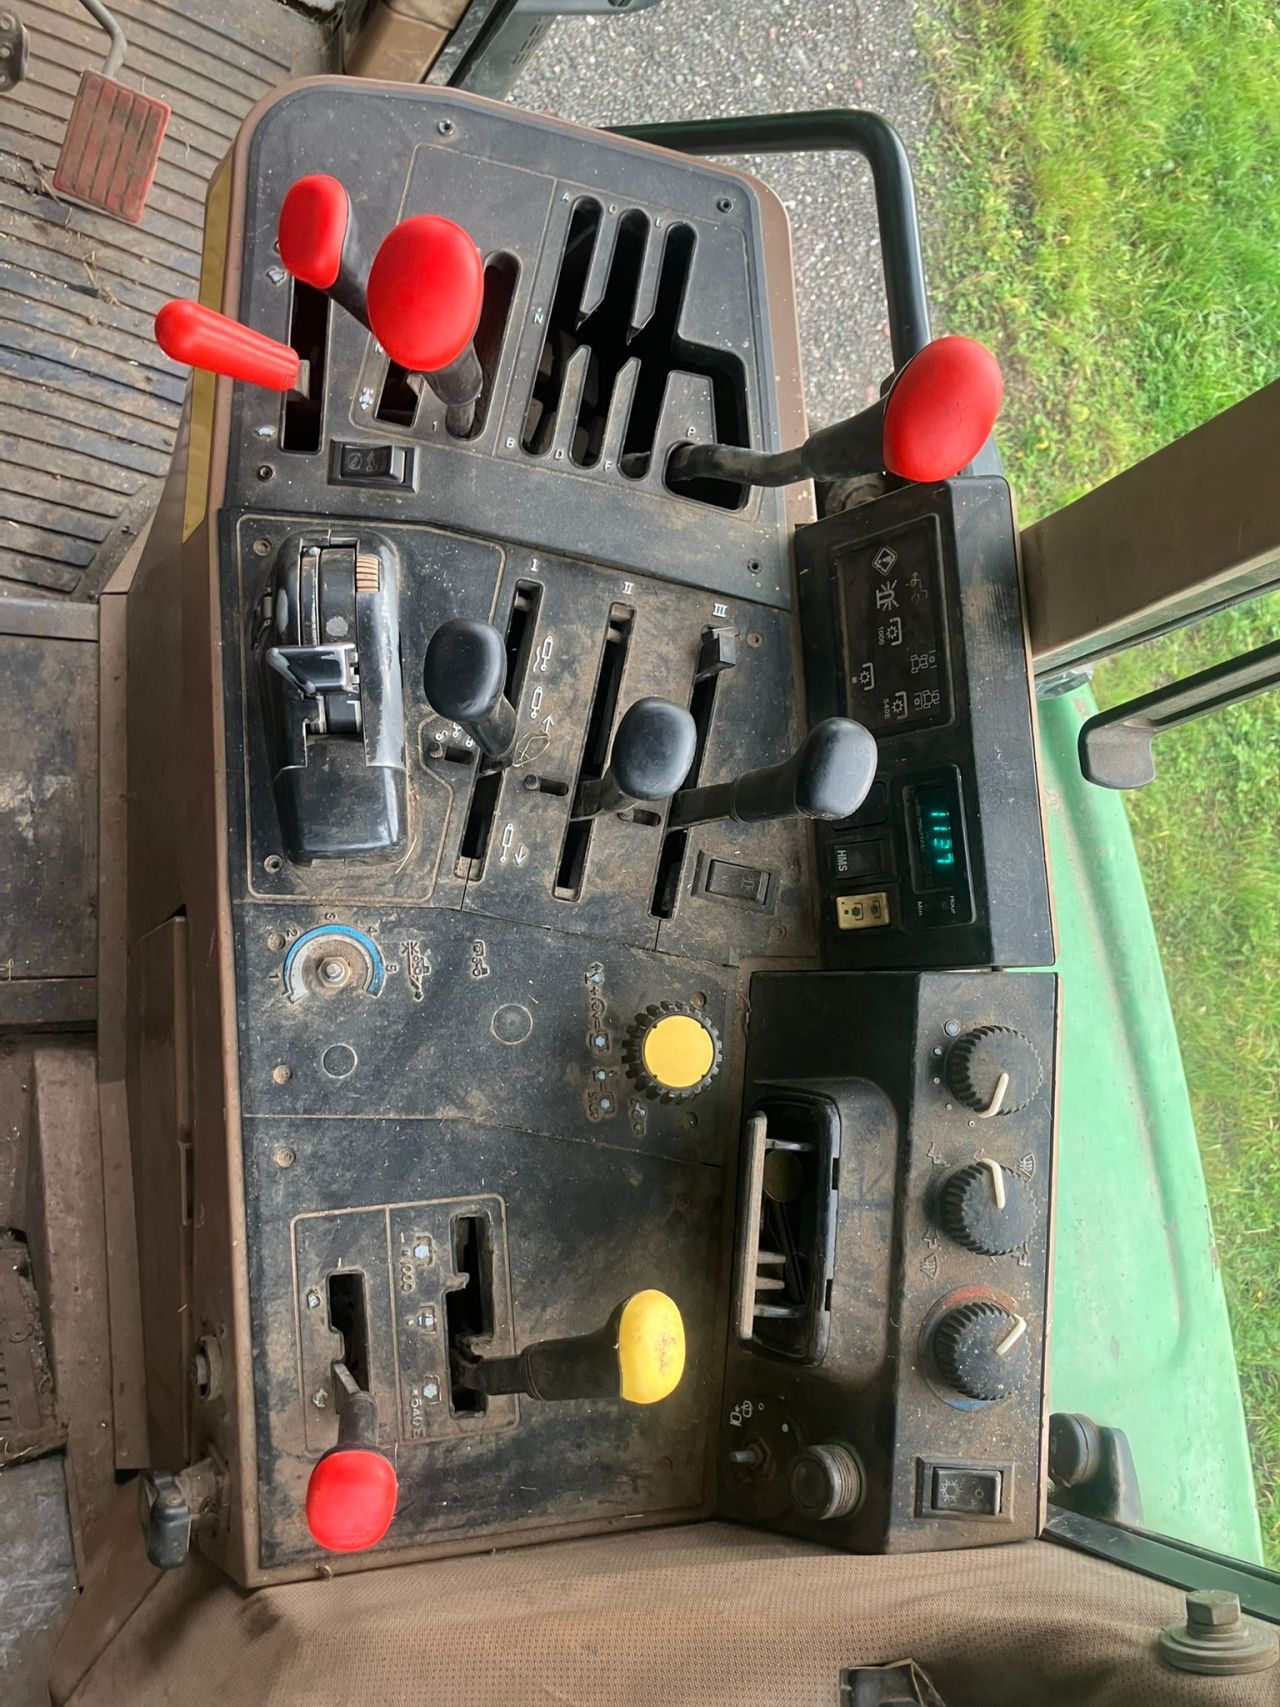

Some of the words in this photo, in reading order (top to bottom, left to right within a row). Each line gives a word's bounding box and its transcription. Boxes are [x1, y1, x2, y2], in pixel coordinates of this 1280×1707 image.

[686, 426, 696, 438] P
[506, 437, 515, 449] B
[554, 449, 565, 460] D
[603, 460, 613, 472] F
[877, 626, 886, 646] 1000
[836, 849, 848, 872] HMS
[948, 895, 957, 915] Hour
